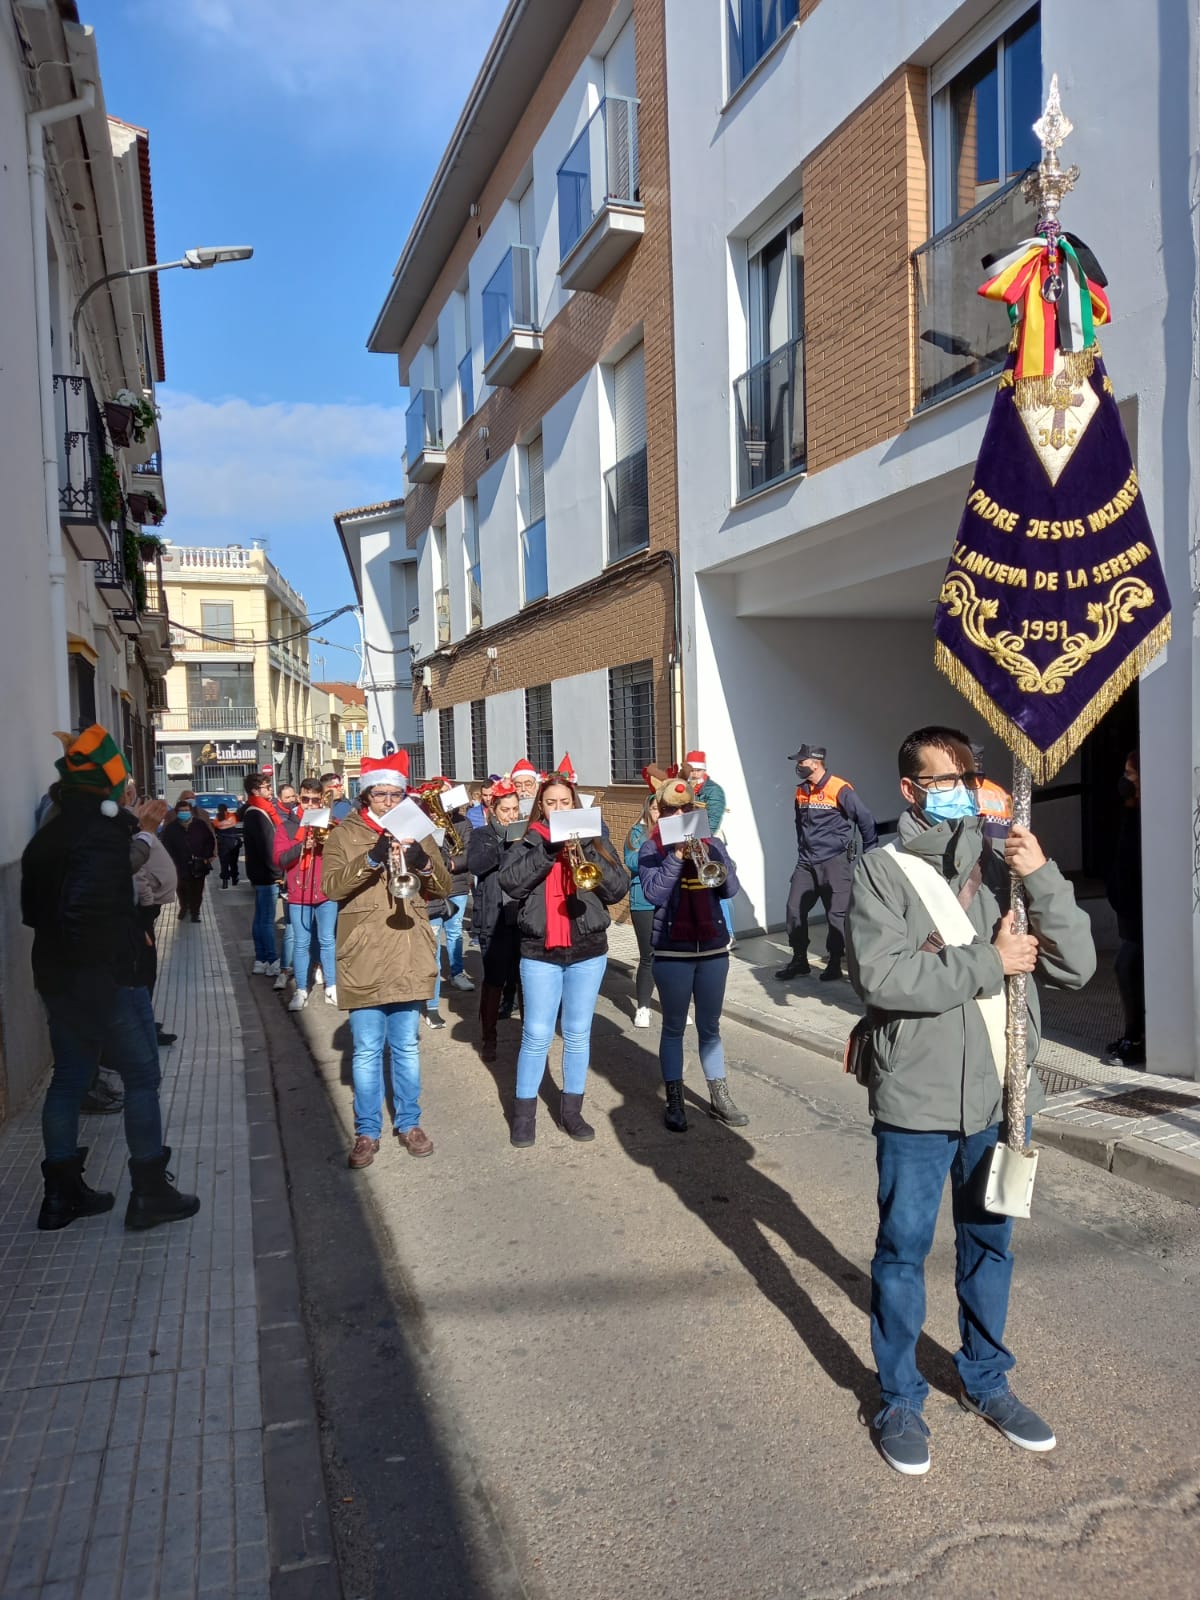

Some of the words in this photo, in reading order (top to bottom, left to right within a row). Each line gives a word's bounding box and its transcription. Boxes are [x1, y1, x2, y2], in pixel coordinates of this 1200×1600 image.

[967, 488, 1020, 532] PADRE
[1026, 519, 1085, 540] JESUS
[1034, 572, 1059, 591] DE
[1067, 569, 1088, 589] LA
[1092, 541, 1152, 584] SERENA
[1021, 619, 1068, 641] 1991
